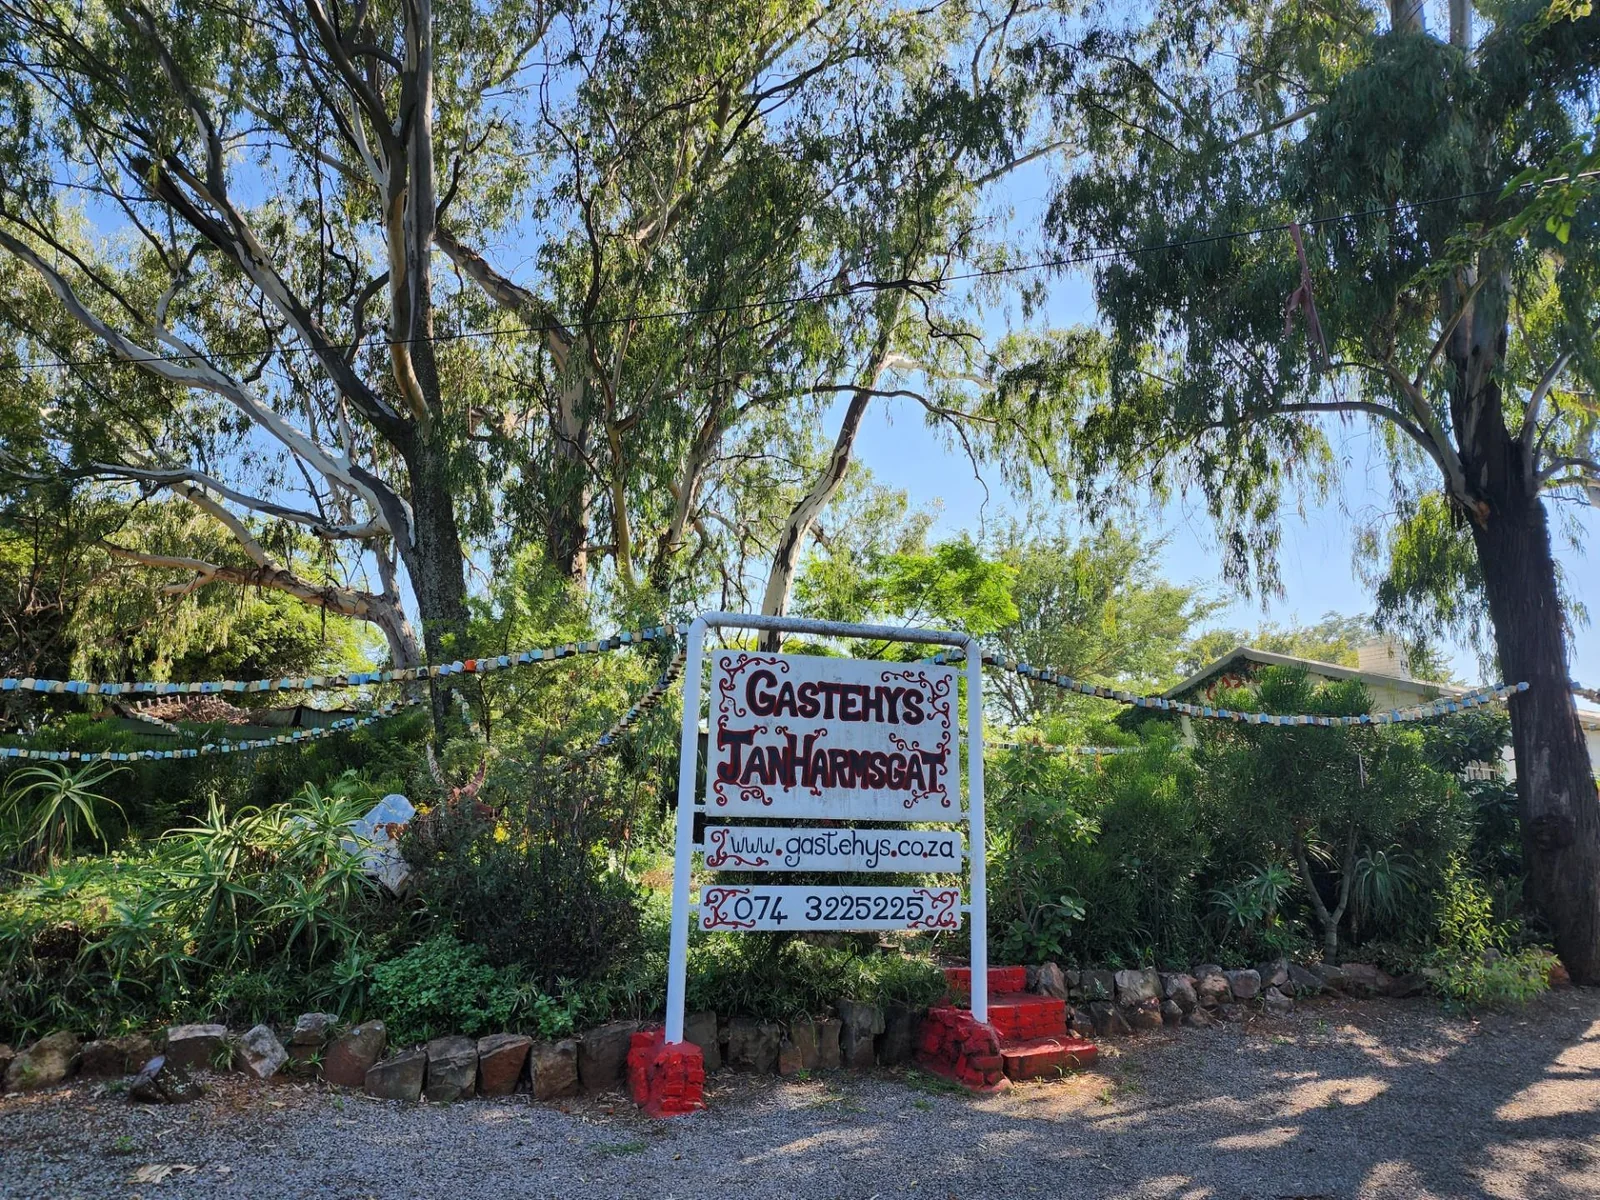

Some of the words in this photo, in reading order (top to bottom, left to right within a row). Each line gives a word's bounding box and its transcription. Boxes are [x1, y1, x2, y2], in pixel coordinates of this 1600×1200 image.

[745, 669, 925, 725] GASTEHYS
[730, 830, 955, 869] www.gastehys.co.za
[733, 896, 788, 925] 074
[804, 895, 924, 921] 3225225
